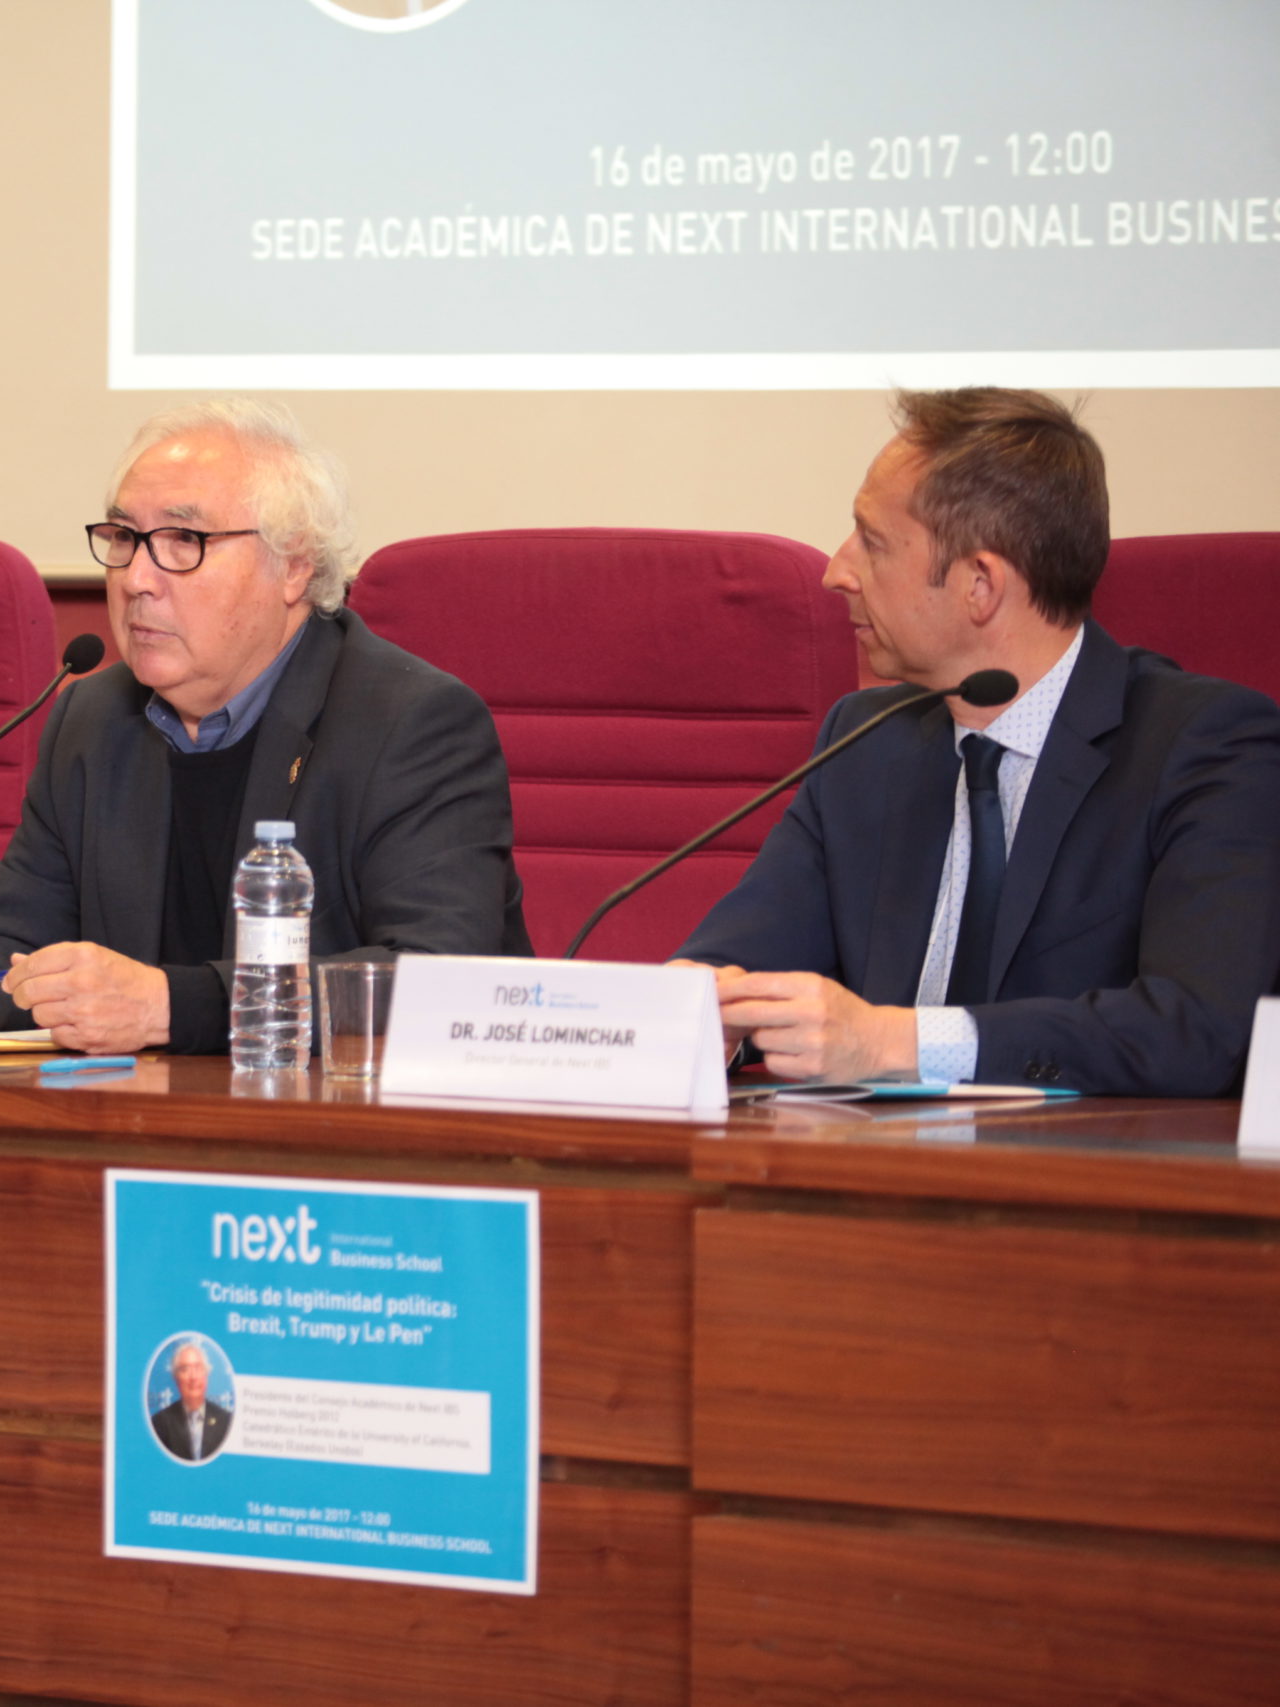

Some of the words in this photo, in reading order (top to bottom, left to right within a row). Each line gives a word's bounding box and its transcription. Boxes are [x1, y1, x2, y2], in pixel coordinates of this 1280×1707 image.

[589, 145, 631, 187] 16
[641, 144, 685, 186] de
[696, 149, 797, 194] mayo
[810, 139, 854, 182] de
[867, 135, 961, 181] 2017
[1005, 130, 1114, 177] 12:00
[250, 217, 344, 260] SEDE
[354, 203, 574, 259] ACADÉMICA
[585, 211, 634, 256] DE
[646, 210, 749, 255] NEXT
[760, 204, 1095, 252] INTERNATIONAL
[493, 982, 544, 1007] next
[450, 1021, 477, 1041] DR.
[483, 1018, 526, 1042] JOSÉ
[531, 1024, 636, 1047] LOMINCHAR
[213, 1204, 321, 1264] next
[330, 1249, 393, 1269] Business
[396, 1253, 443, 1272] School
[262, 1286, 281, 1306] de
[286, 1288, 382, 1313] legitimidad
[228, 1312, 286, 1338] Brexit,
[288, 1316, 347, 1344] Trump
[350, 1326, 361, 1345] y
[364, 1322, 385, 1343] Le
